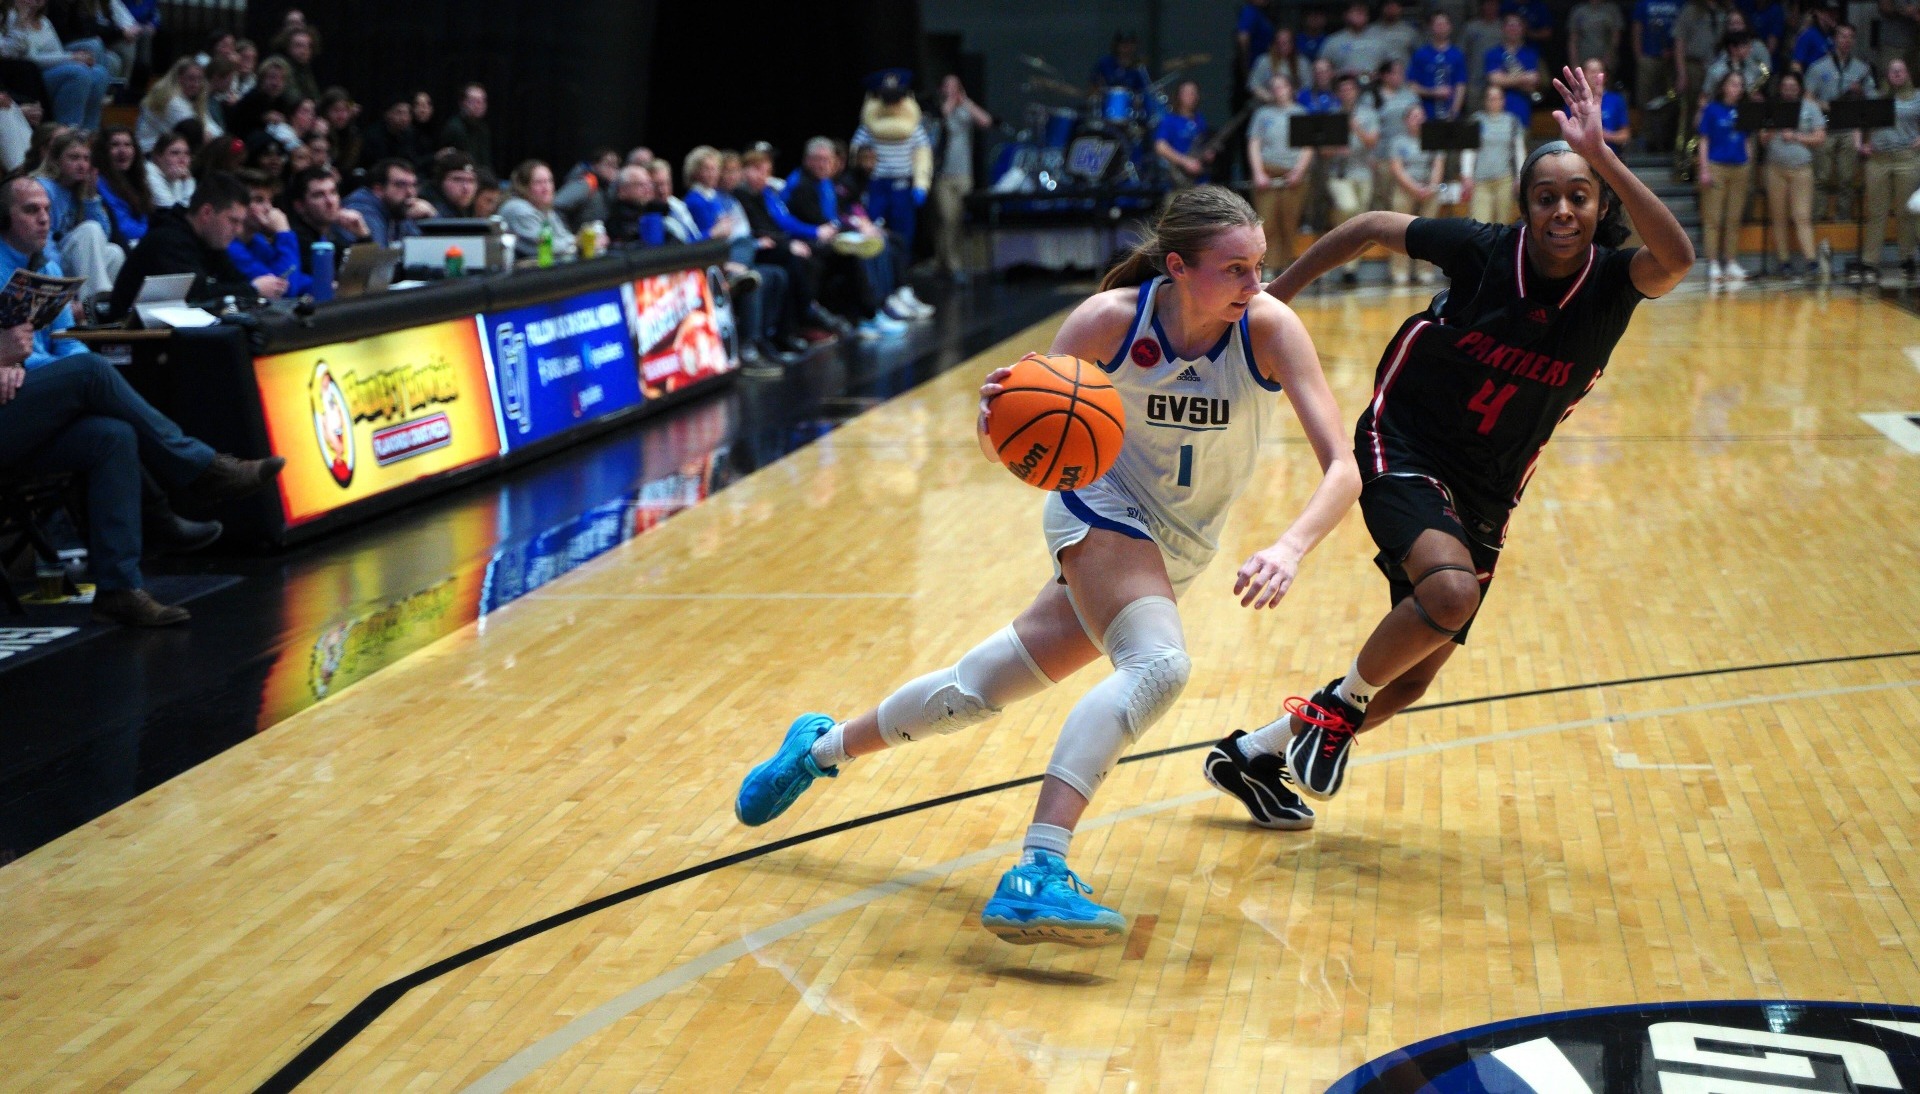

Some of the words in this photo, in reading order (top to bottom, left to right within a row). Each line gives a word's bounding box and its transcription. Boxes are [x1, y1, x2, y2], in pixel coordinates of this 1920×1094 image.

[1455, 331, 1575, 387] PANTHERS
[1147, 394, 1230, 425] GVSU
[1467, 378, 1519, 436] 4
[1008, 442, 1049, 479] lson
[1178, 444, 1193, 487] 1
